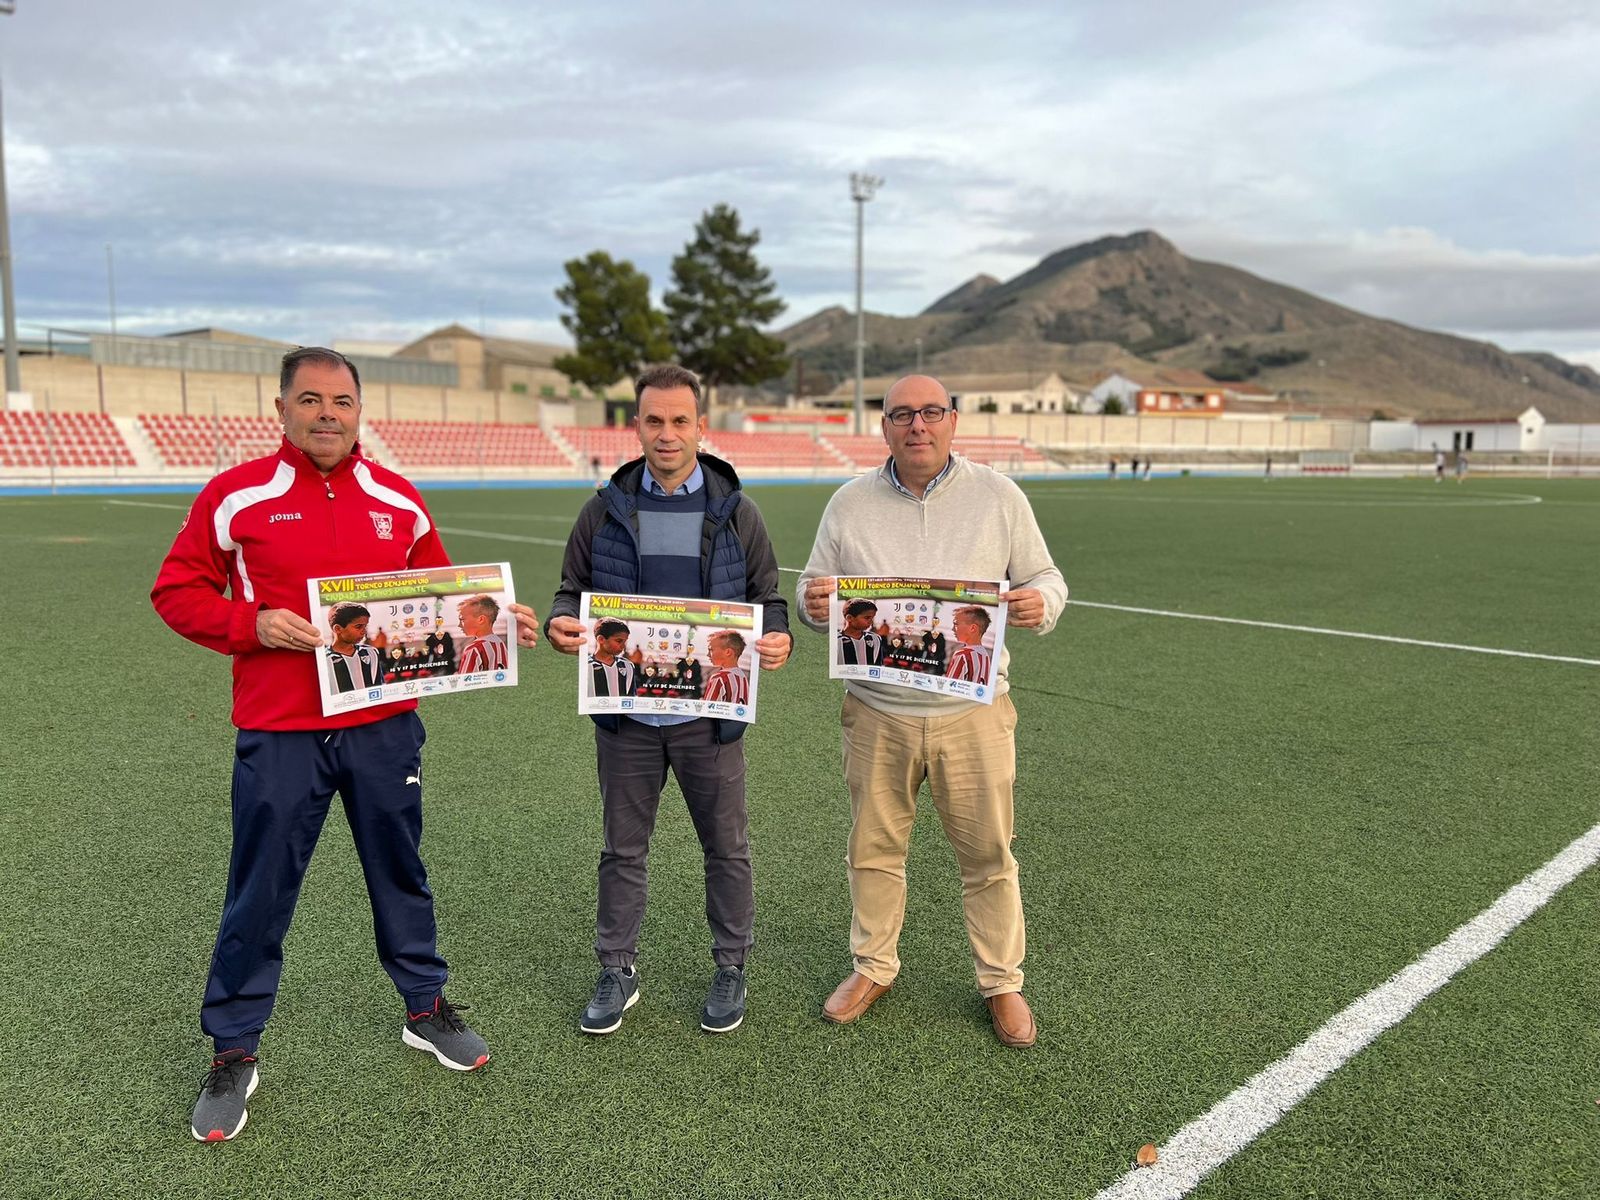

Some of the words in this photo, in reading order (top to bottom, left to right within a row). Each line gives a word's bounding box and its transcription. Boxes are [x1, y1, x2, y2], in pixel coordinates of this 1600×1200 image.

[320, 578, 354, 592] XVIII
[356, 582, 382, 590] TORNEO
[384, 578, 417, 588] BENJAMIN
[840, 578, 866, 589] XVIII
[591, 595, 621, 608] XVIII
[914, 657, 939, 665] DICIEMBRE
